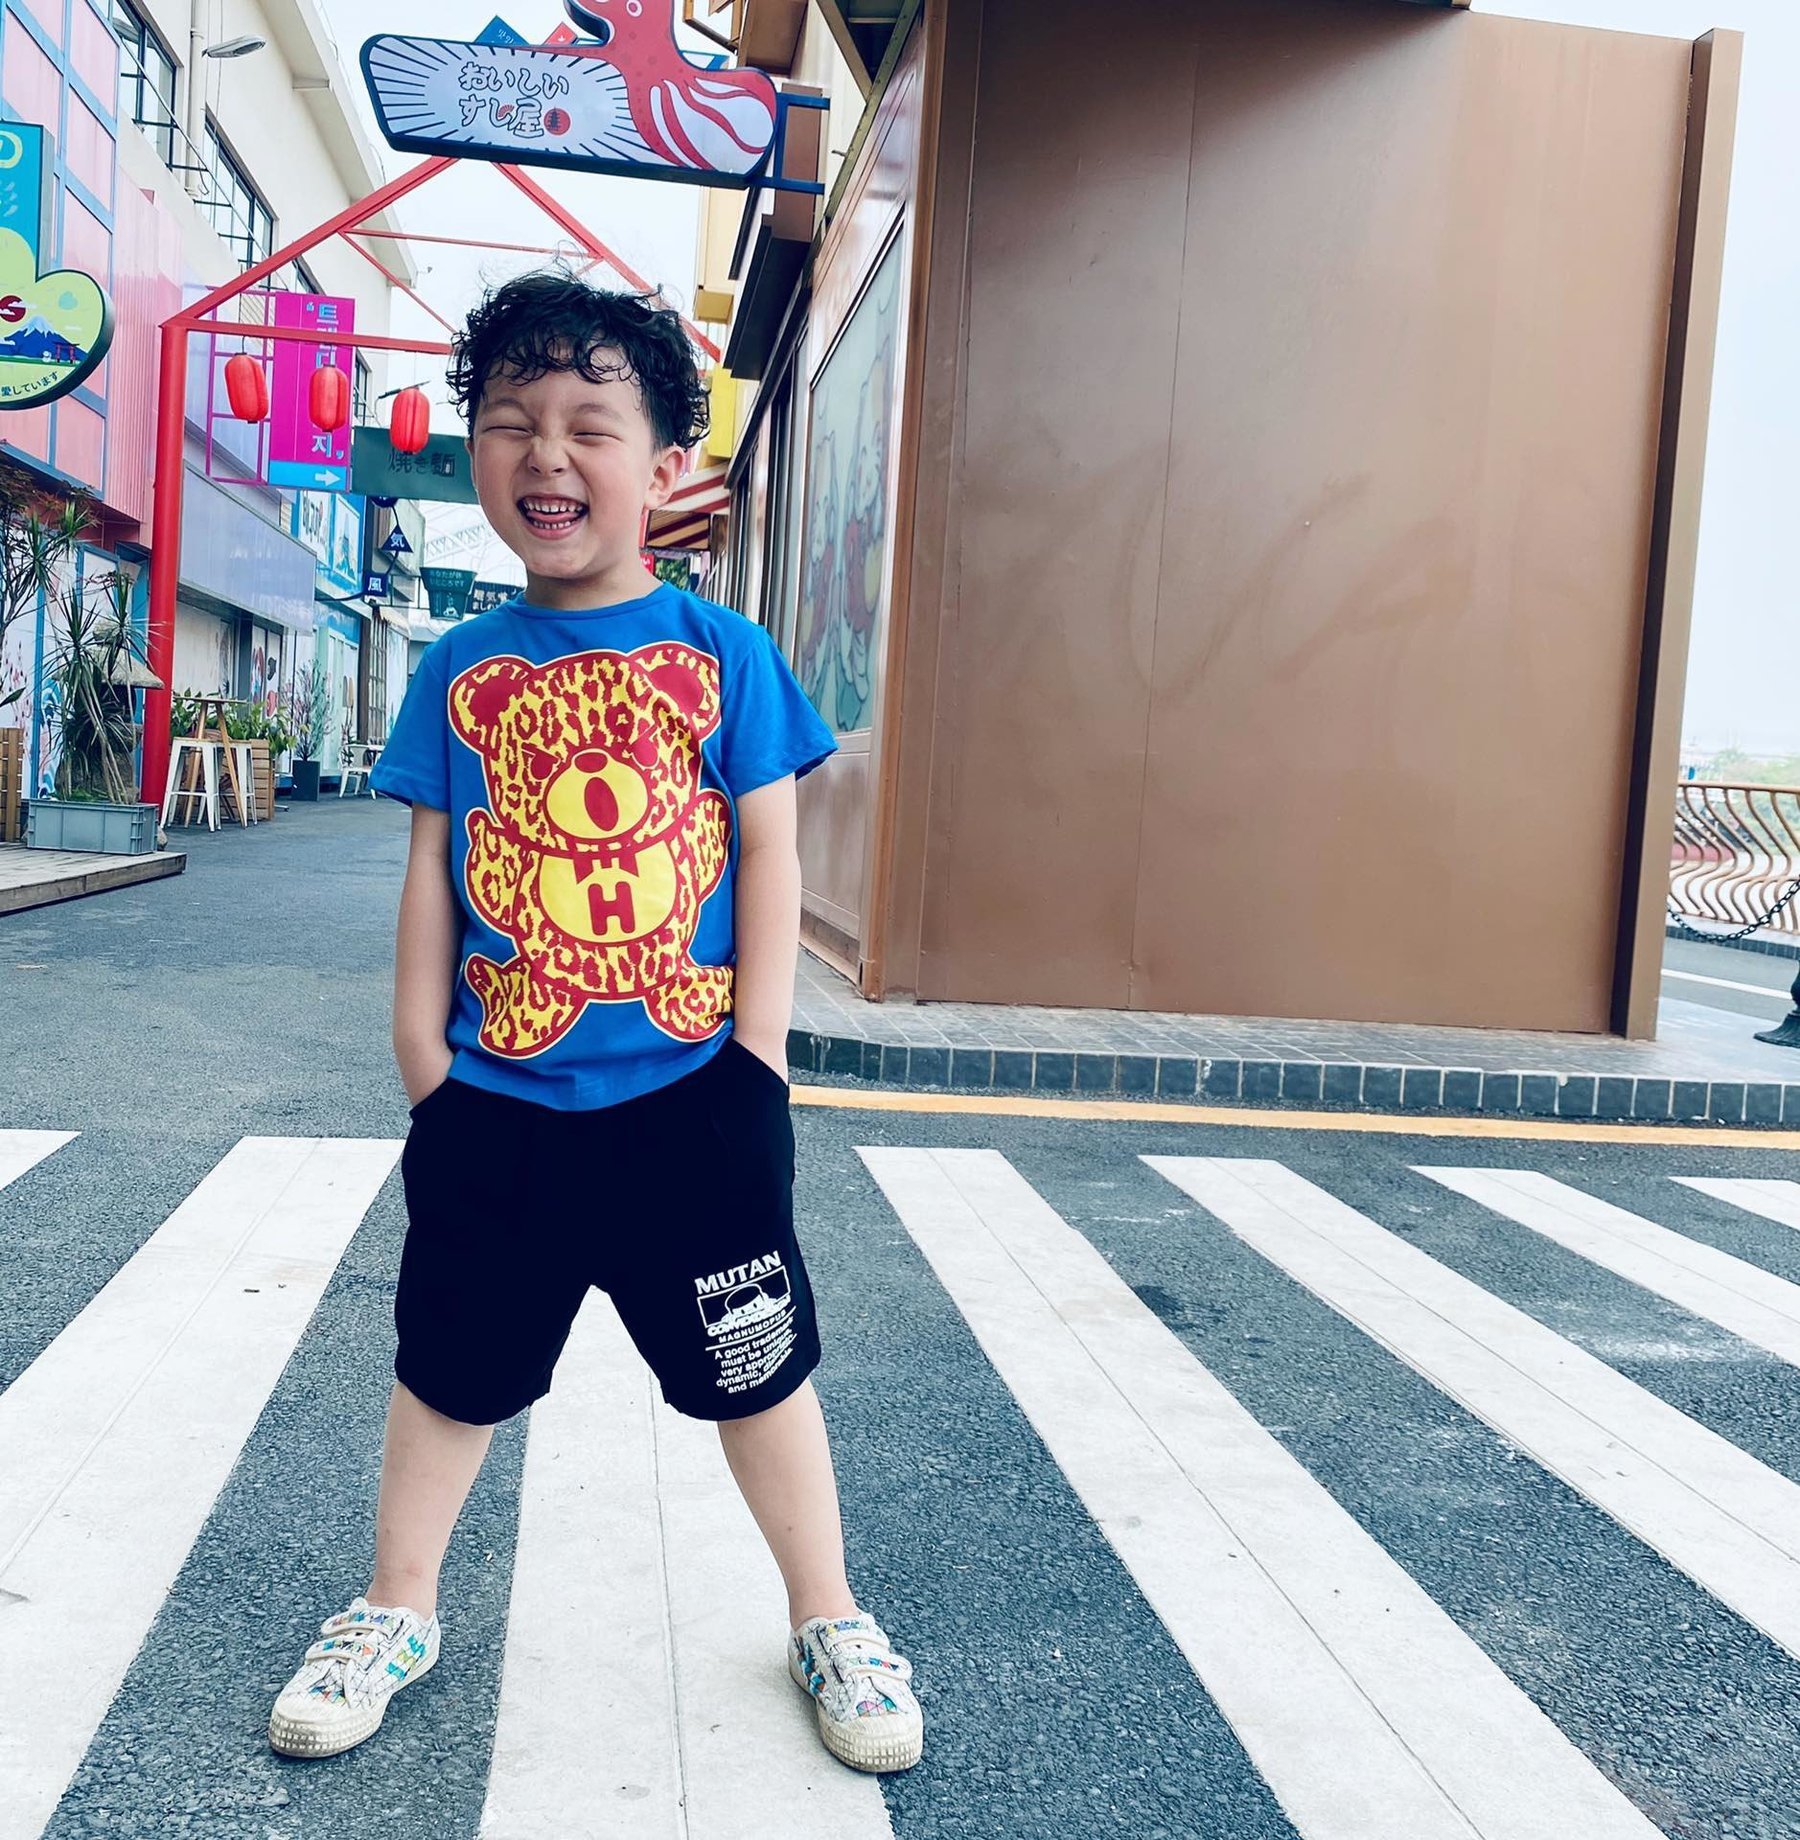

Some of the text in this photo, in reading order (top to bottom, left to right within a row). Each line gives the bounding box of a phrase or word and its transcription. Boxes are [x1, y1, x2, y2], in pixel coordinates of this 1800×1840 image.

[458, 61, 569, 99] おいしい
[458, 94, 544, 138] すし屋
[587, 881, 635, 936] H
[694, 1250, 782, 1295] MUTAN
[715, 1350, 723, 1360] A
[724, 1342, 751, 1359] good
[721, 1354, 747, 1369] must
[748, 1350, 762, 1361] be
[716, 1370, 762, 1389] dynamic,
[721, 1365, 743, 1378] very
[728, 1382, 748, 1394] and
